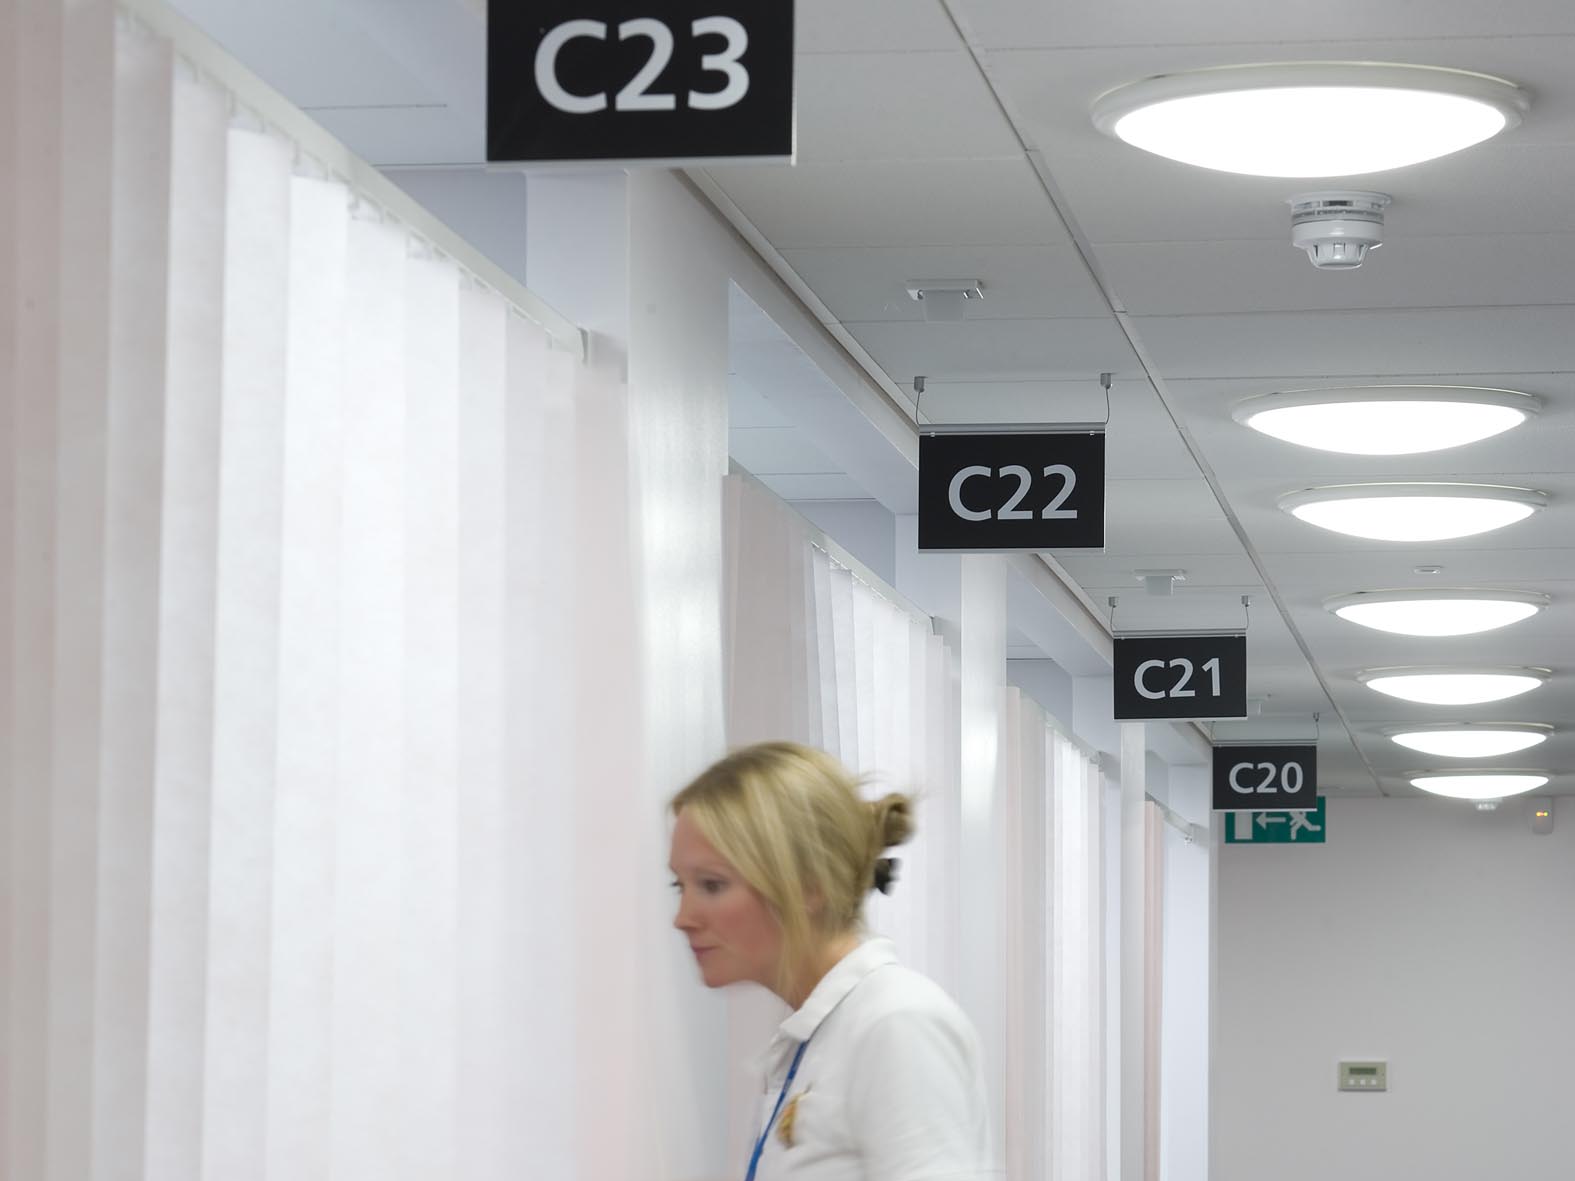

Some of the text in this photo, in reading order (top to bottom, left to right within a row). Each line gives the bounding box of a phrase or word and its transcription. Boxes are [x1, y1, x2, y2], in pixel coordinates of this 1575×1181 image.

[535, 16, 750, 113] C23
[948, 464, 1078, 522] C22
[1133, 657, 1221, 700] C21
[1229, 761, 1303, 794] C20
